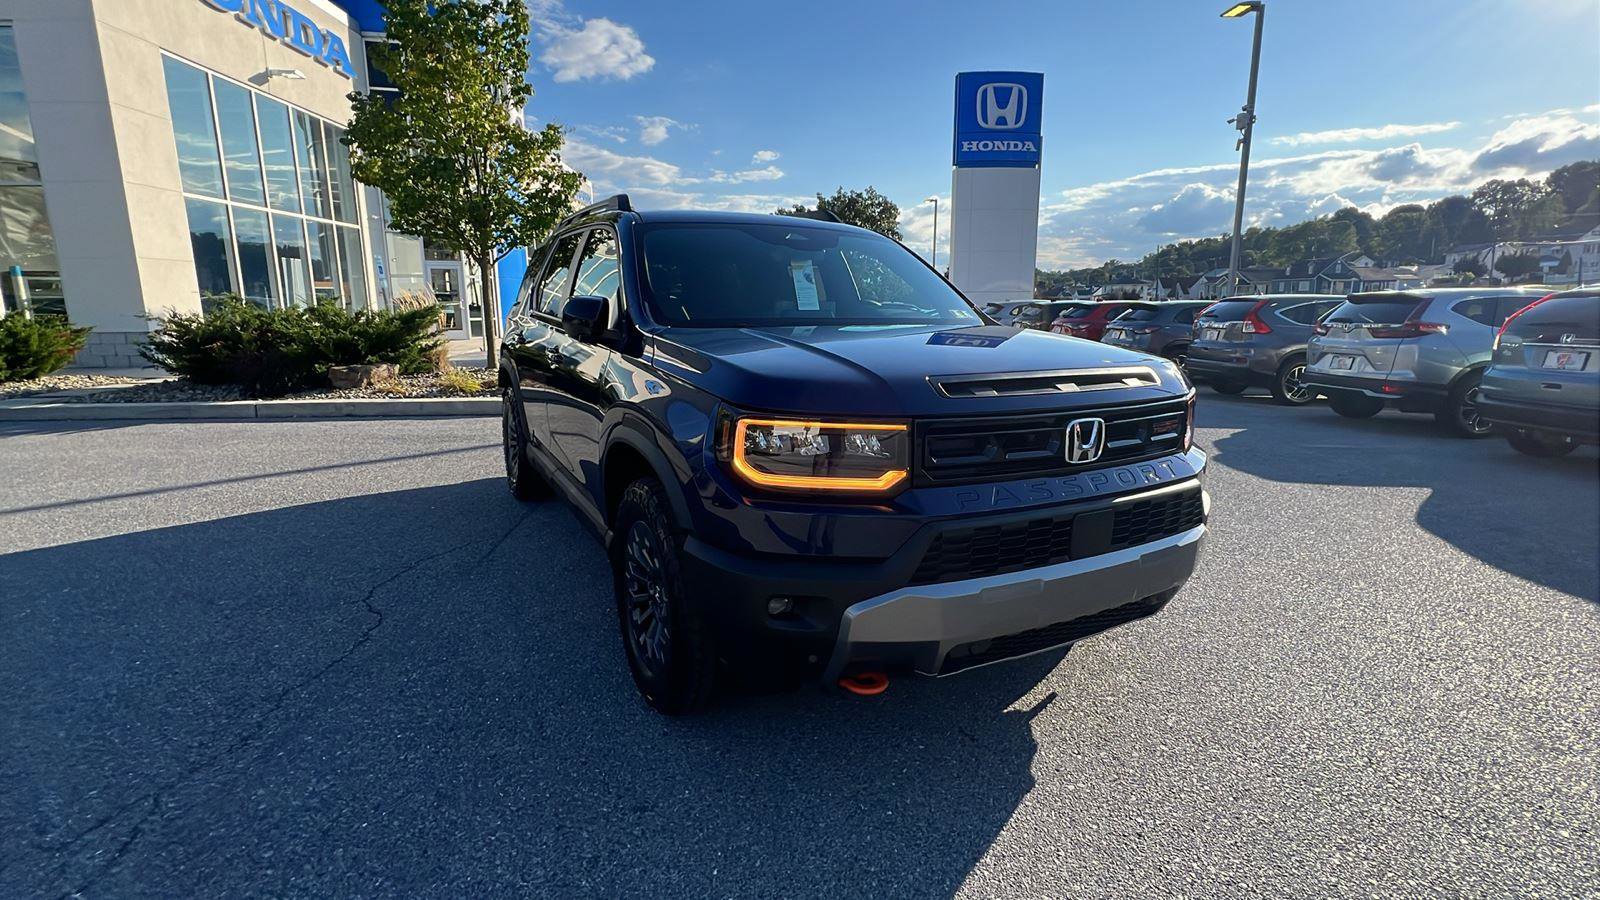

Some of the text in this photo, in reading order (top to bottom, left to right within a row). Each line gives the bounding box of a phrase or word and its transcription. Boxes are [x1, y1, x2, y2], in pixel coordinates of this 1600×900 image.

[199, 0, 357, 79] NDA
[961, 141, 1037, 152] HONDA
[955, 459, 1178, 509] PASSPORT
